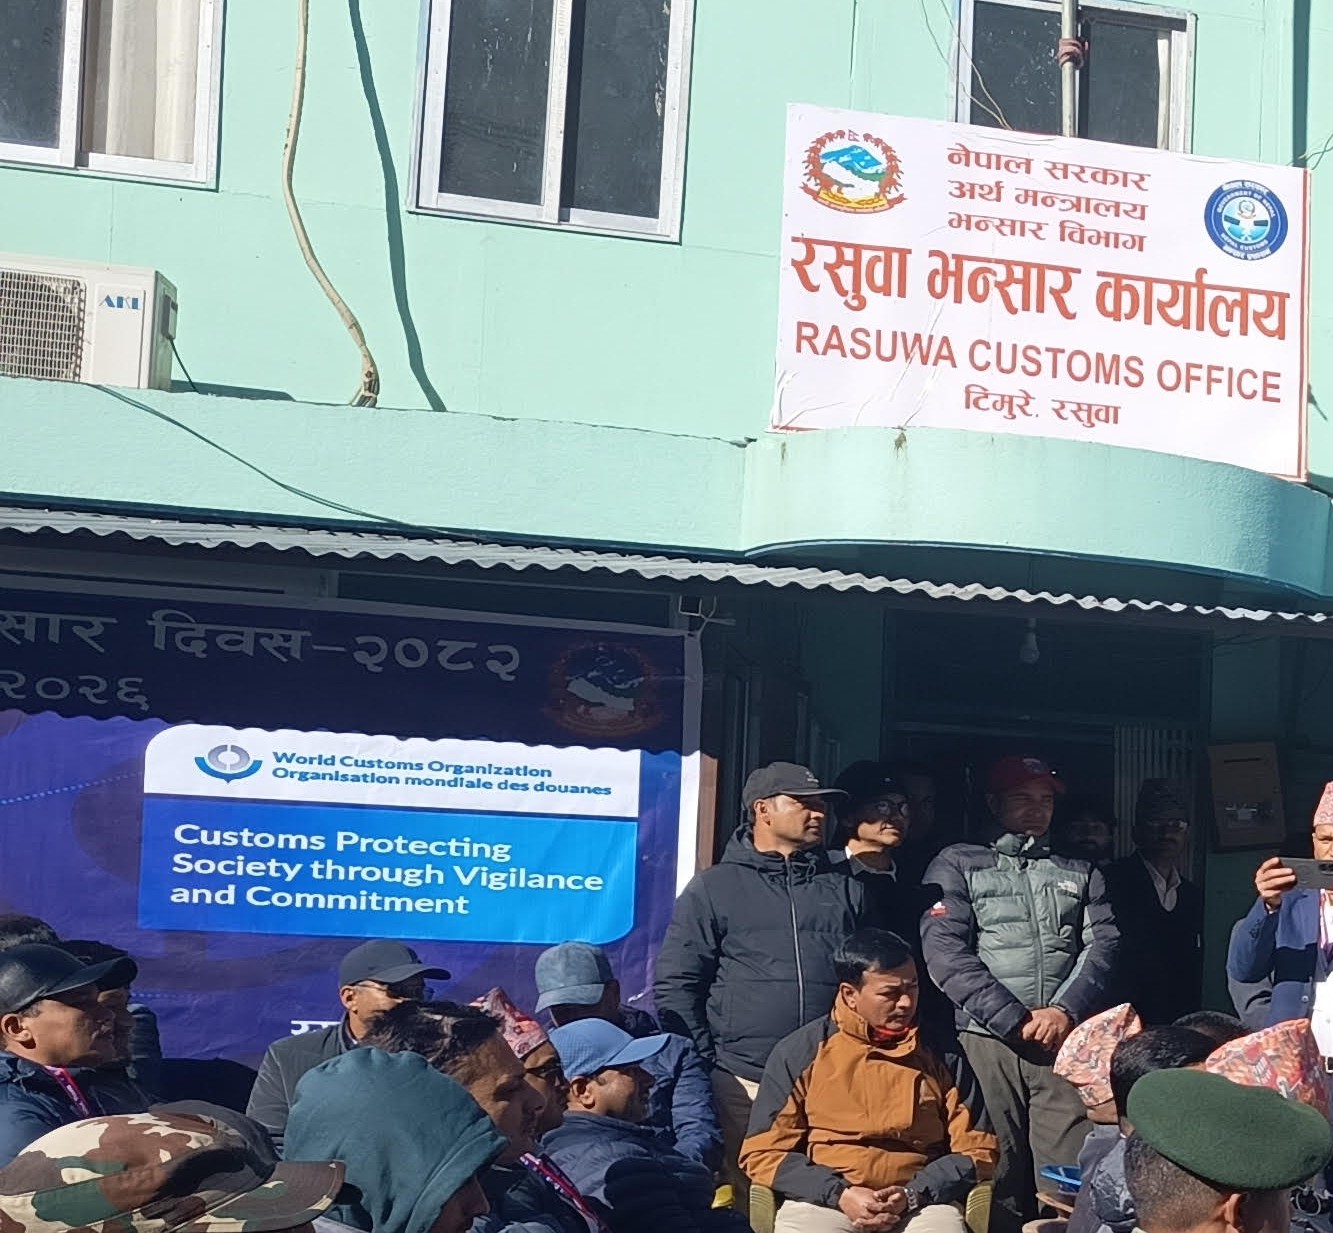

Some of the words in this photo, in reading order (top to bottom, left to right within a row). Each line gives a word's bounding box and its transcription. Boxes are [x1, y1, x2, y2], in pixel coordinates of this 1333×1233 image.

[946, 142, 1032, 175] नेपाल
[1043, 160, 1151, 192] सरकार
[948, 179, 1004, 202] अर्थ
[1014, 187, 1148, 221] मन्त्रालय
[948, 211, 1049, 242] भन्सार
[1058, 220, 1146, 252] विभाग
[790, 235, 912, 312] रसुवा
[926, 249, 1081, 322] भन्सार
[1096, 267, 1290, 341] कार्यालय
[795, 321, 957, 369] RASUWA
[968, 339, 1145, 388] CUSTOMS
[1156, 359, 1281, 403] OFFICE
[1050, 396, 1121, 428] रसुवा
[146, 608, 521, 681] दिवस-२०८२
[0, 669, 149, 711] २०२६
[271, 766, 401, 786] Organisation
[404, 773, 494, 790] mondiale
[499, 779, 529, 792] des
[533, 780, 612, 797] douanes
[273, 750, 336, 768] World
[339, 755, 423, 773] Customs
[428, 760, 553, 779] Organization
[174, 823, 326, 852] Customs
[336, 830, 511, 862] Protecting
[172, 852, 304, 882] Society
[310, 859, 445, 887] through
[453, 864, 604, 892] Vigilance
[170, 882, 236, 906] and
[245, 885, 470, 915] Commitment
